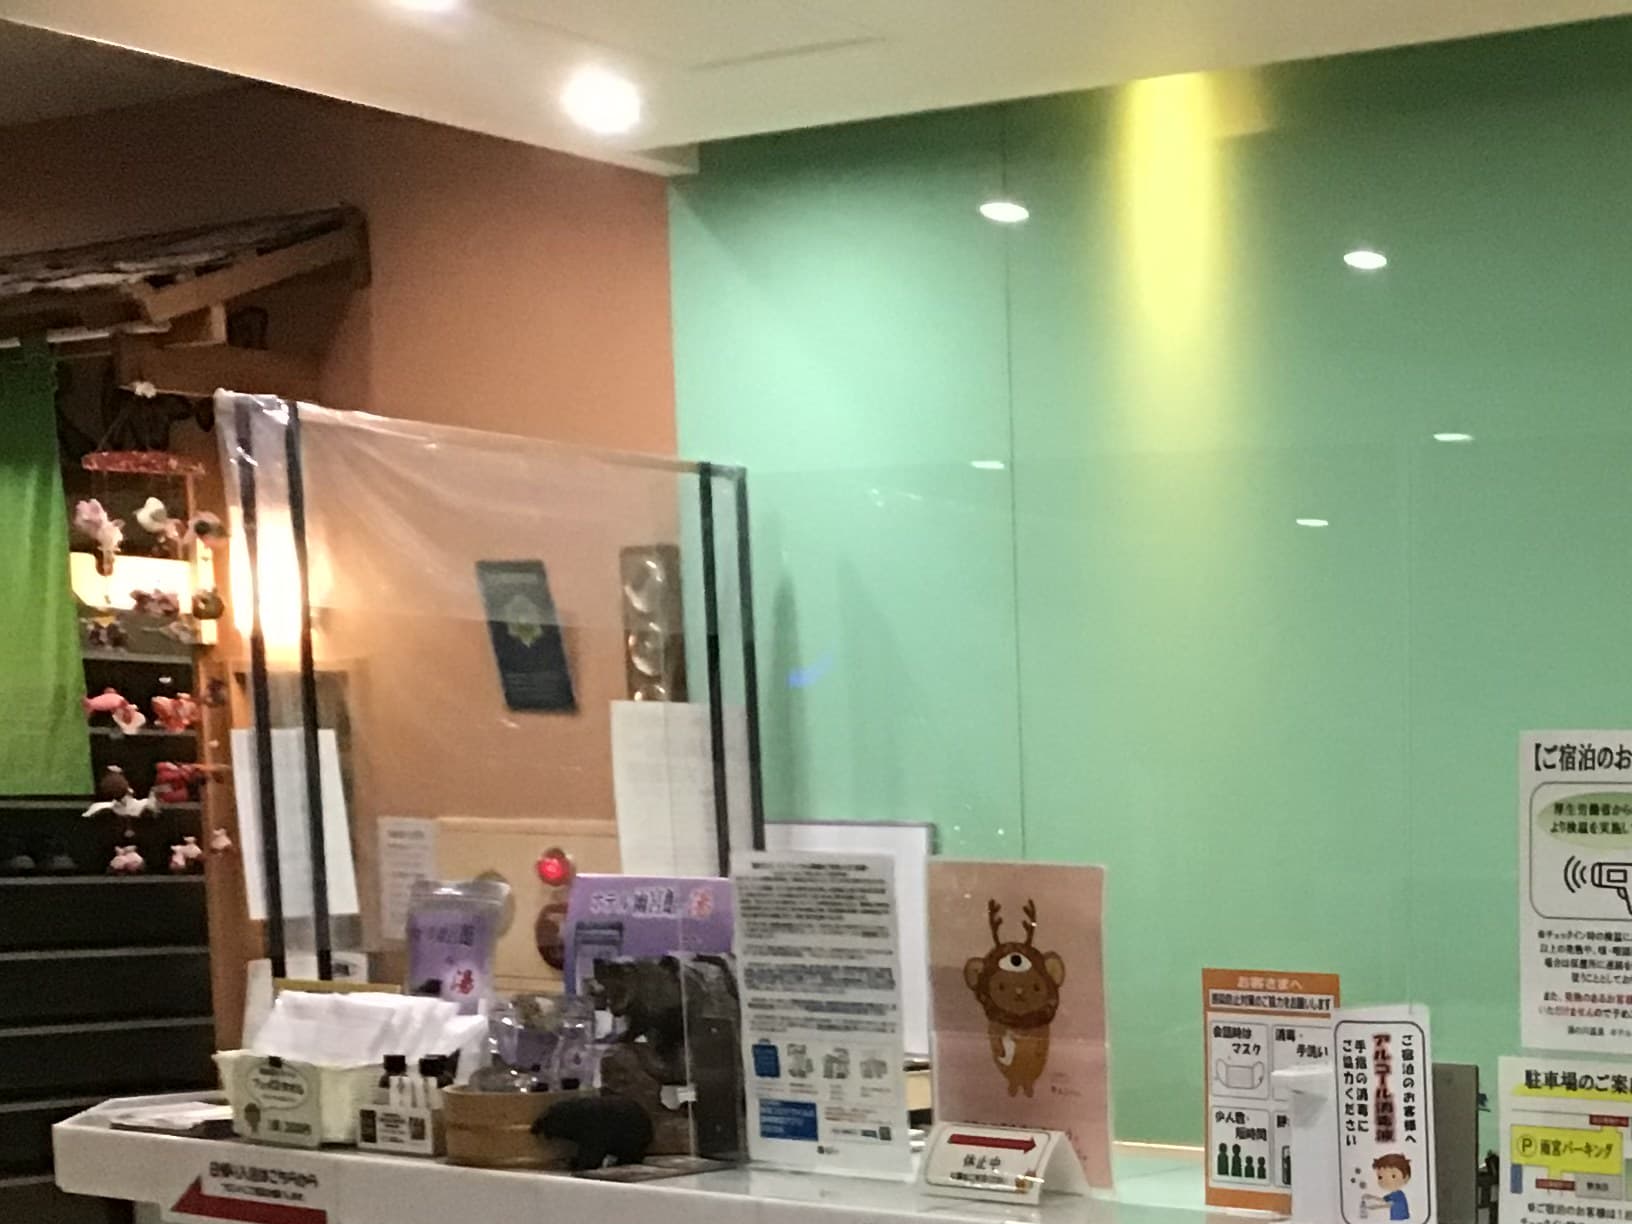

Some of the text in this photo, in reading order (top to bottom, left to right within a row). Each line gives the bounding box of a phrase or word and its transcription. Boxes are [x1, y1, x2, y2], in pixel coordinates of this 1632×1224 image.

[1232, 1043, 1262, 1056] マスク
[1402, 1035, 1417, 1143] ご宿泊のお客様へ
